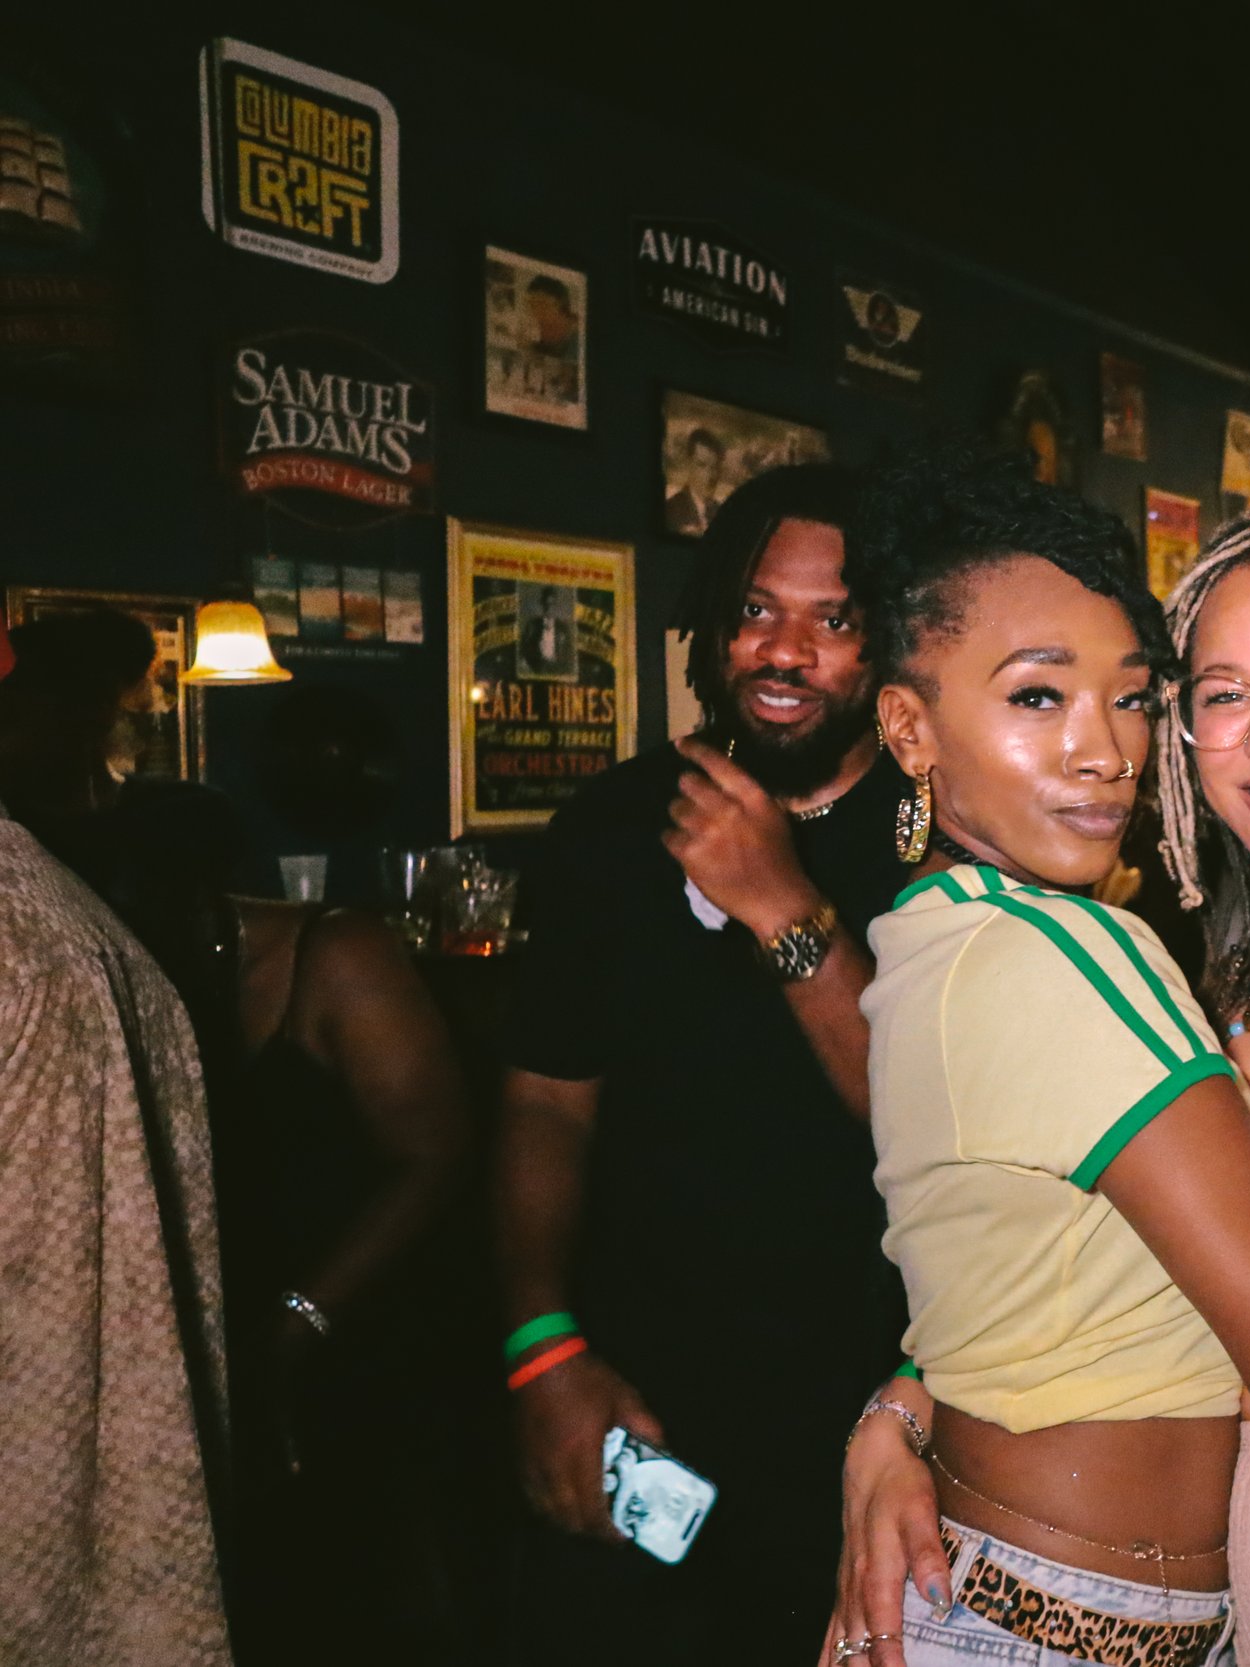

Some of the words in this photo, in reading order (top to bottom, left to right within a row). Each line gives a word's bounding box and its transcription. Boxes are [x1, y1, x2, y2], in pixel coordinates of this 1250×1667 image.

[238, 139, 371, 248] CRAFT
[639, 228, 787, 307] AVIATION
[662, 286, 739, 328] AMERICAN
[233, 348, 427, 434] SAMUEL
[246, 403, 413, 475] ADAMS
[242, 461, 335, 491] BOSTON
[343, 474, 414, 506] LAGER
[477, 681, 539, 722] EARL
[549, 684, 615, 725] HINES
[504, 728, 552, 747] GRAND
[557, 729, 613, 749] TERRACE
[483, 752, 609, 777] ORCHESTRA
